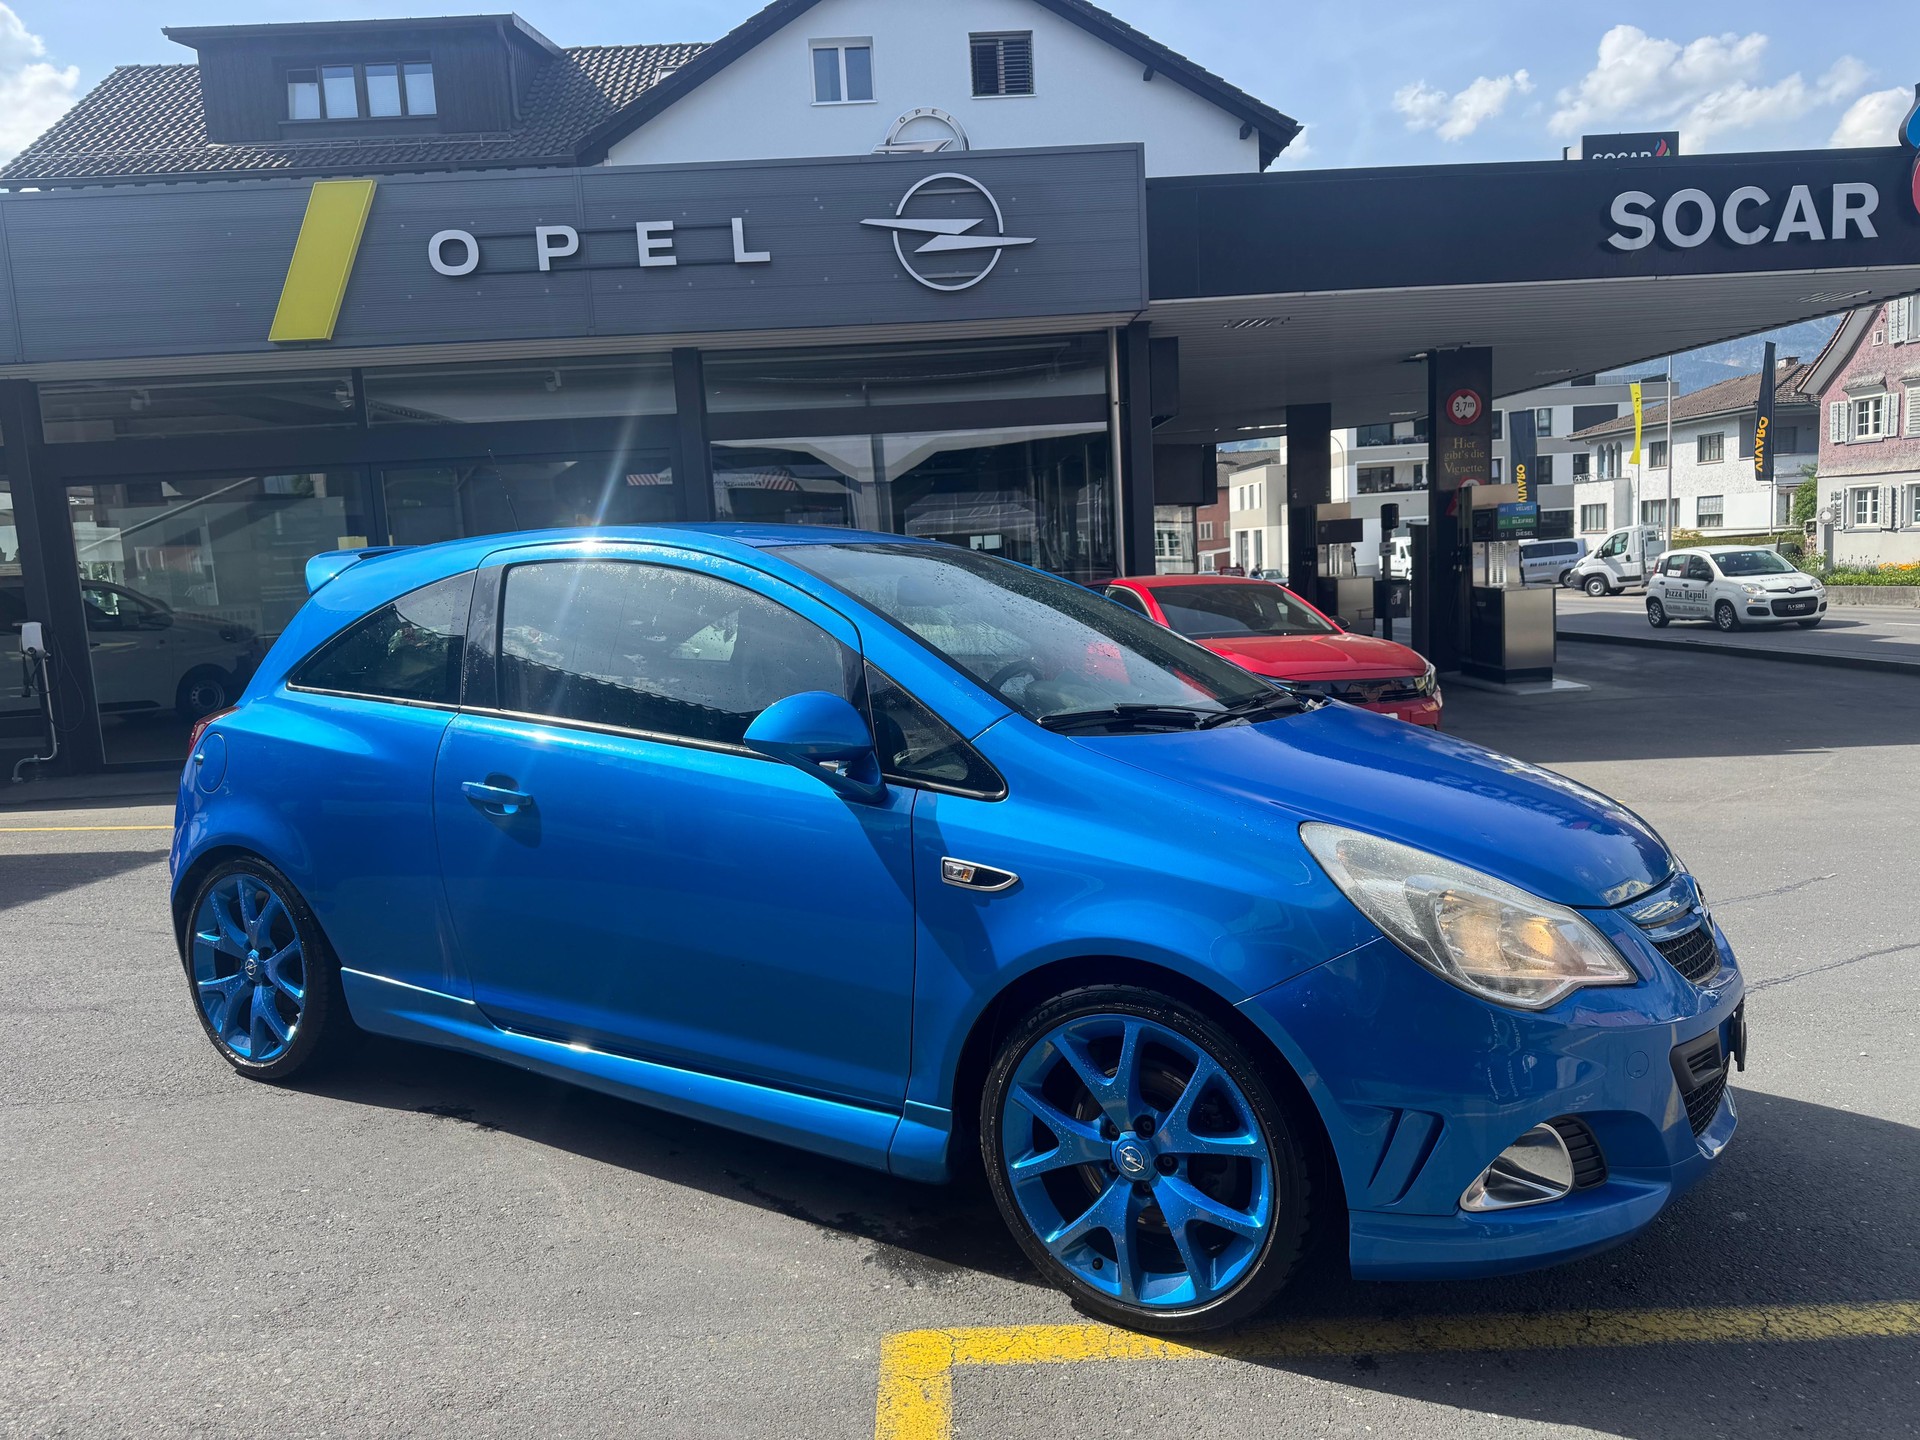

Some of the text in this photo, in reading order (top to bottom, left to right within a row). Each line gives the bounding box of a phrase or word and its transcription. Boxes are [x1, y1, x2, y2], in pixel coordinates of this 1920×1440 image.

[899, 108, 952, 124] OPEL
[1607, 182, 1880, 251] SOCAR
[427, 217, 772, 277] OPEL
[1454, 437, 1476, 449] Hier
[1444, 449, 1485, 461] gibt's die
[1444, 462, 1485, 475] Vignette.
[1665, 588, 1708, 602] Pizza Napoli
